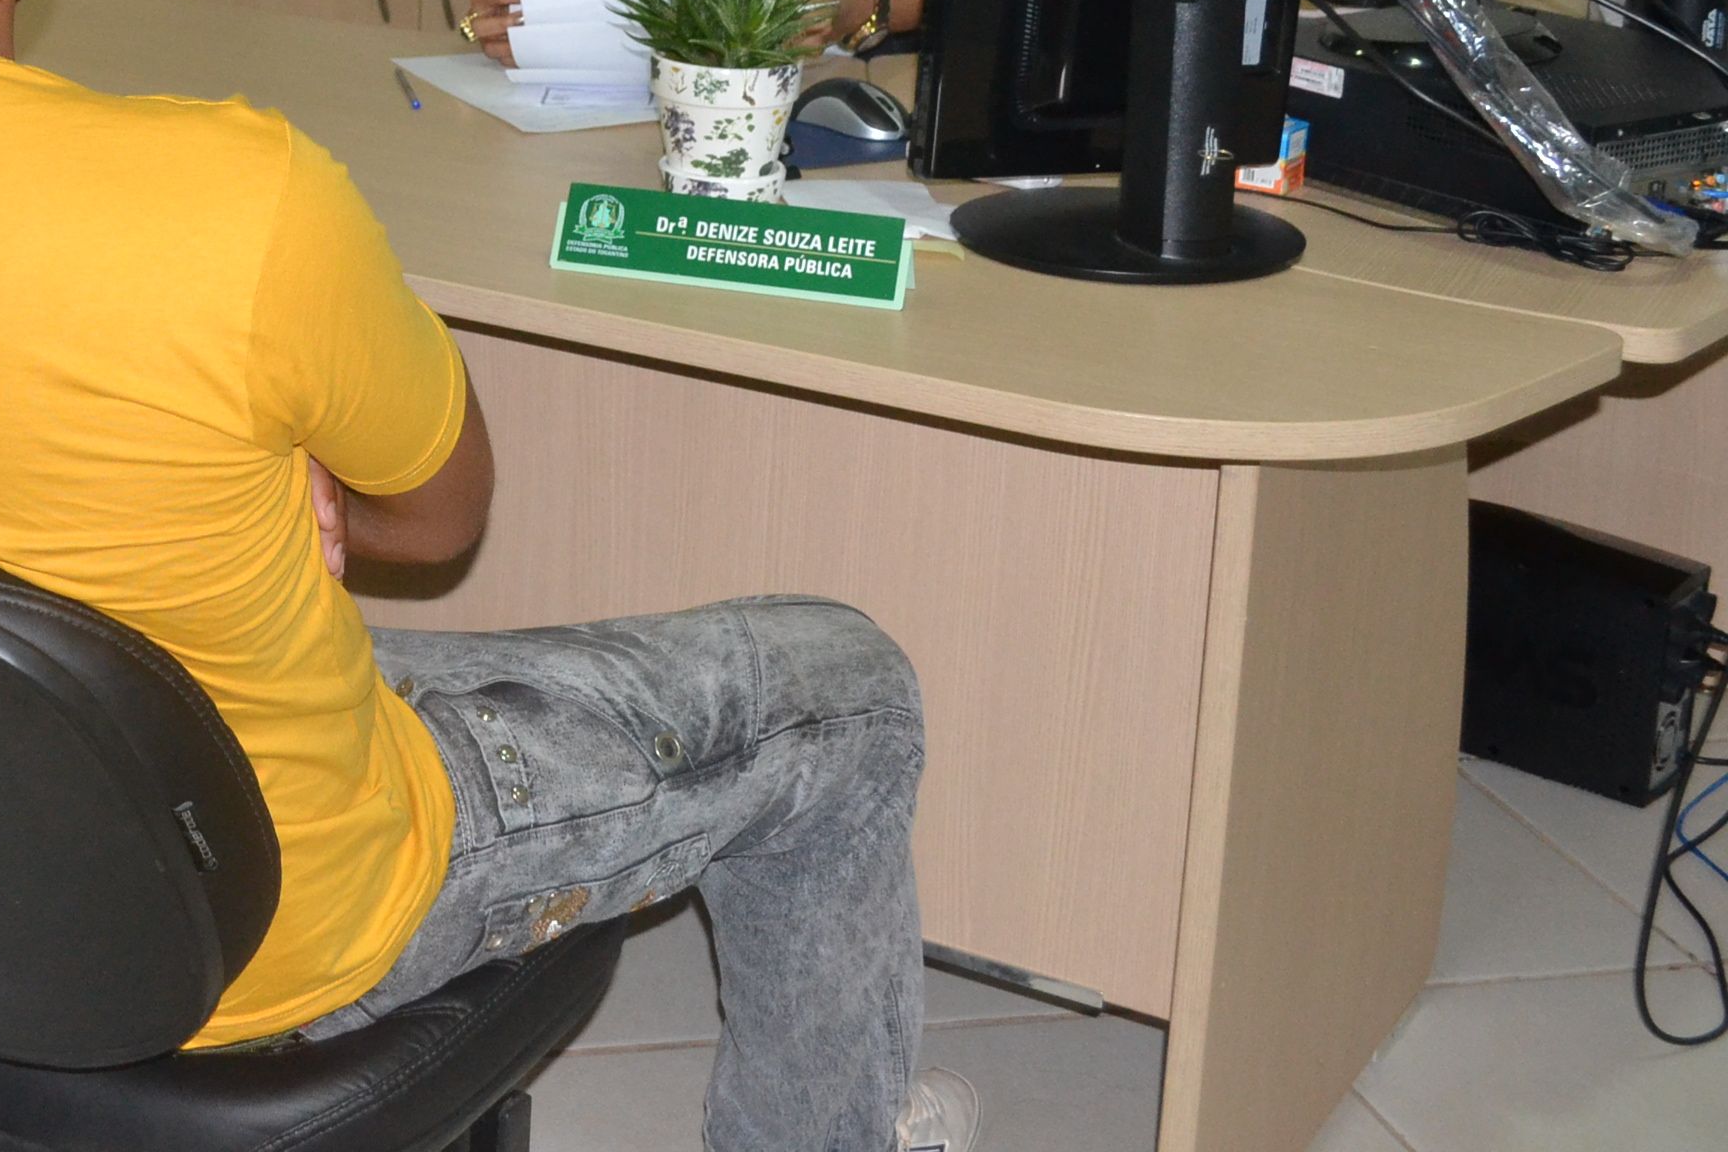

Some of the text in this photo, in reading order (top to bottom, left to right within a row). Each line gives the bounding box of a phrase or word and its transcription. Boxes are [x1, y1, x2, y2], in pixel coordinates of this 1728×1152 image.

[695, 220, 759, 244] DENIZE
[763, 229, 822, 252] SOUZA
[828, 236, 877, 257] LEITE
[686, 245, 853, 280] DEFENSORA PÚBLICA
